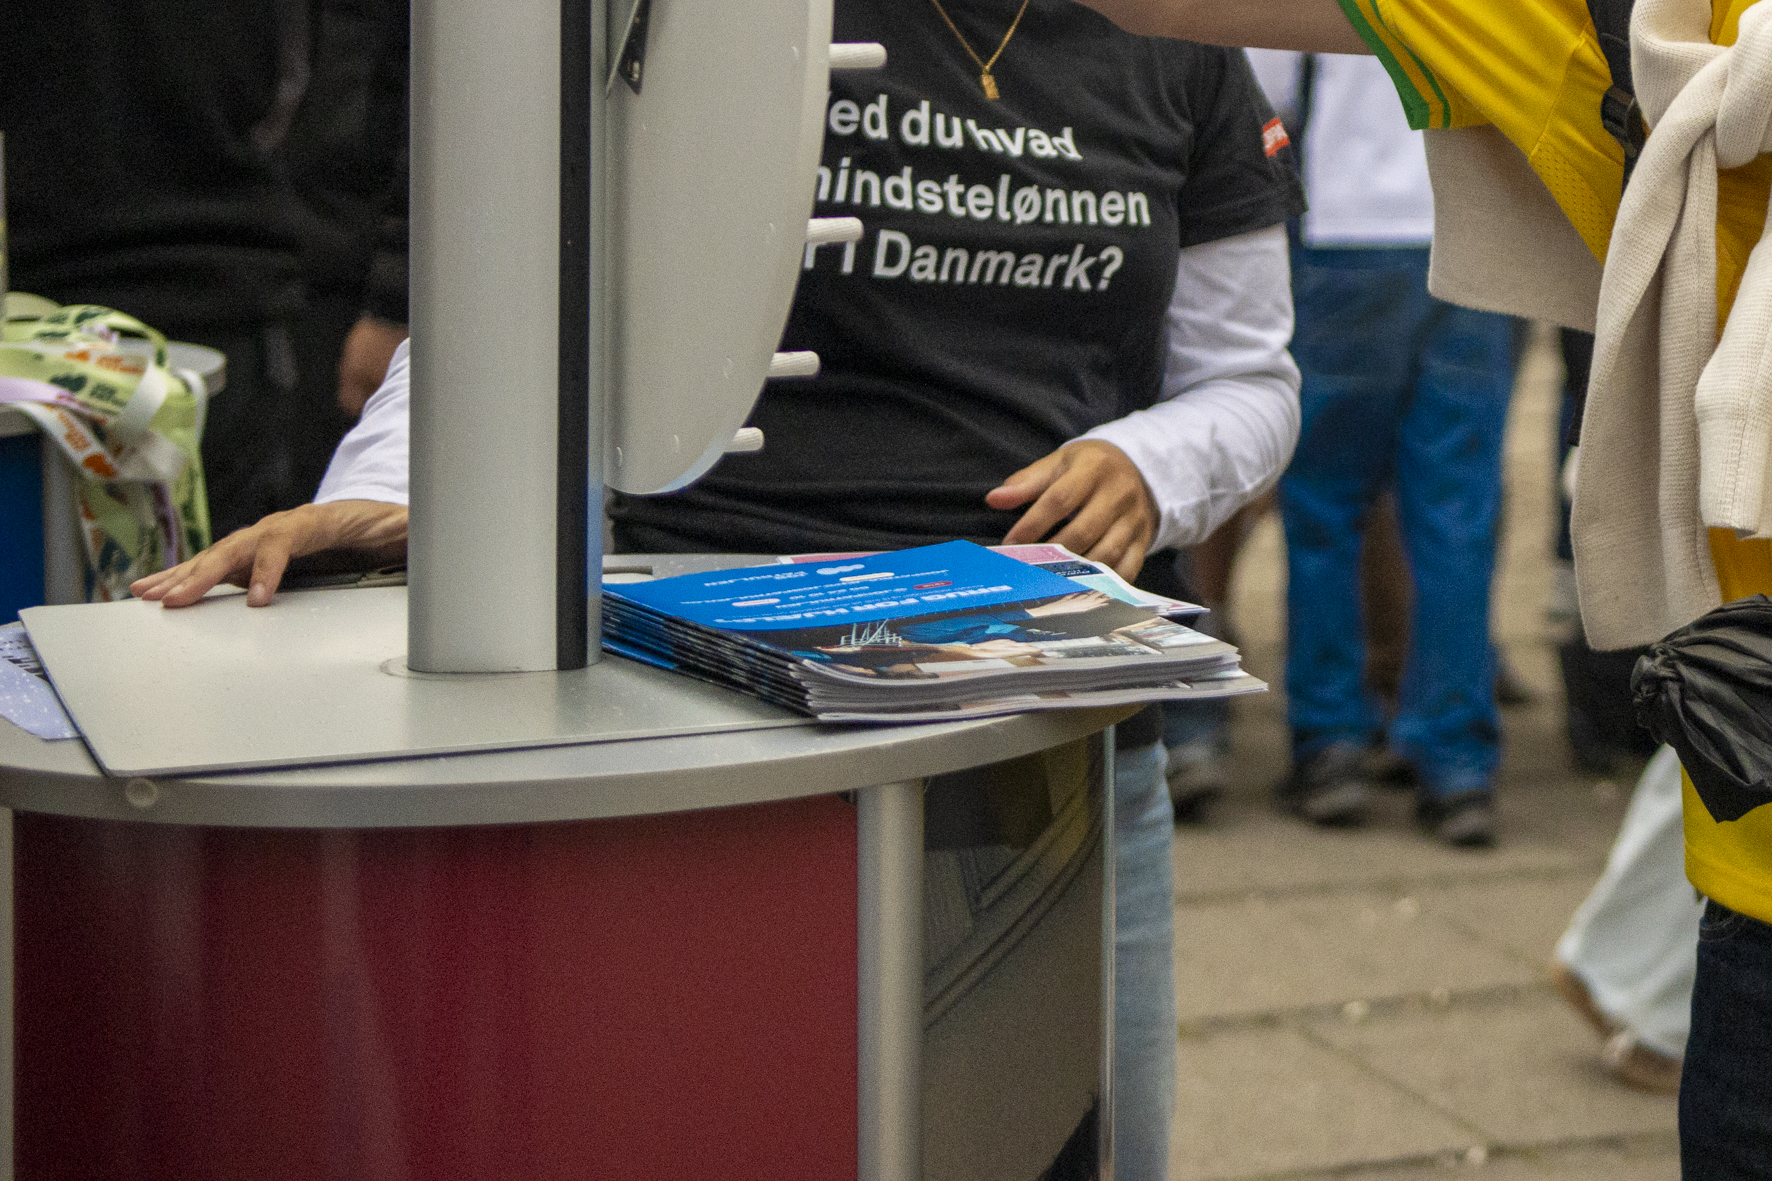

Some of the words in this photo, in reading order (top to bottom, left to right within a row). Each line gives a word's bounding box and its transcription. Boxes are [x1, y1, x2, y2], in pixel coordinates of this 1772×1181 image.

[828, 91, 889, 140] ed
[901, 99, 964, 149] du
[966, 118, 1083, 161] hvad
[872, 228, 1124, 291] Danmark?
